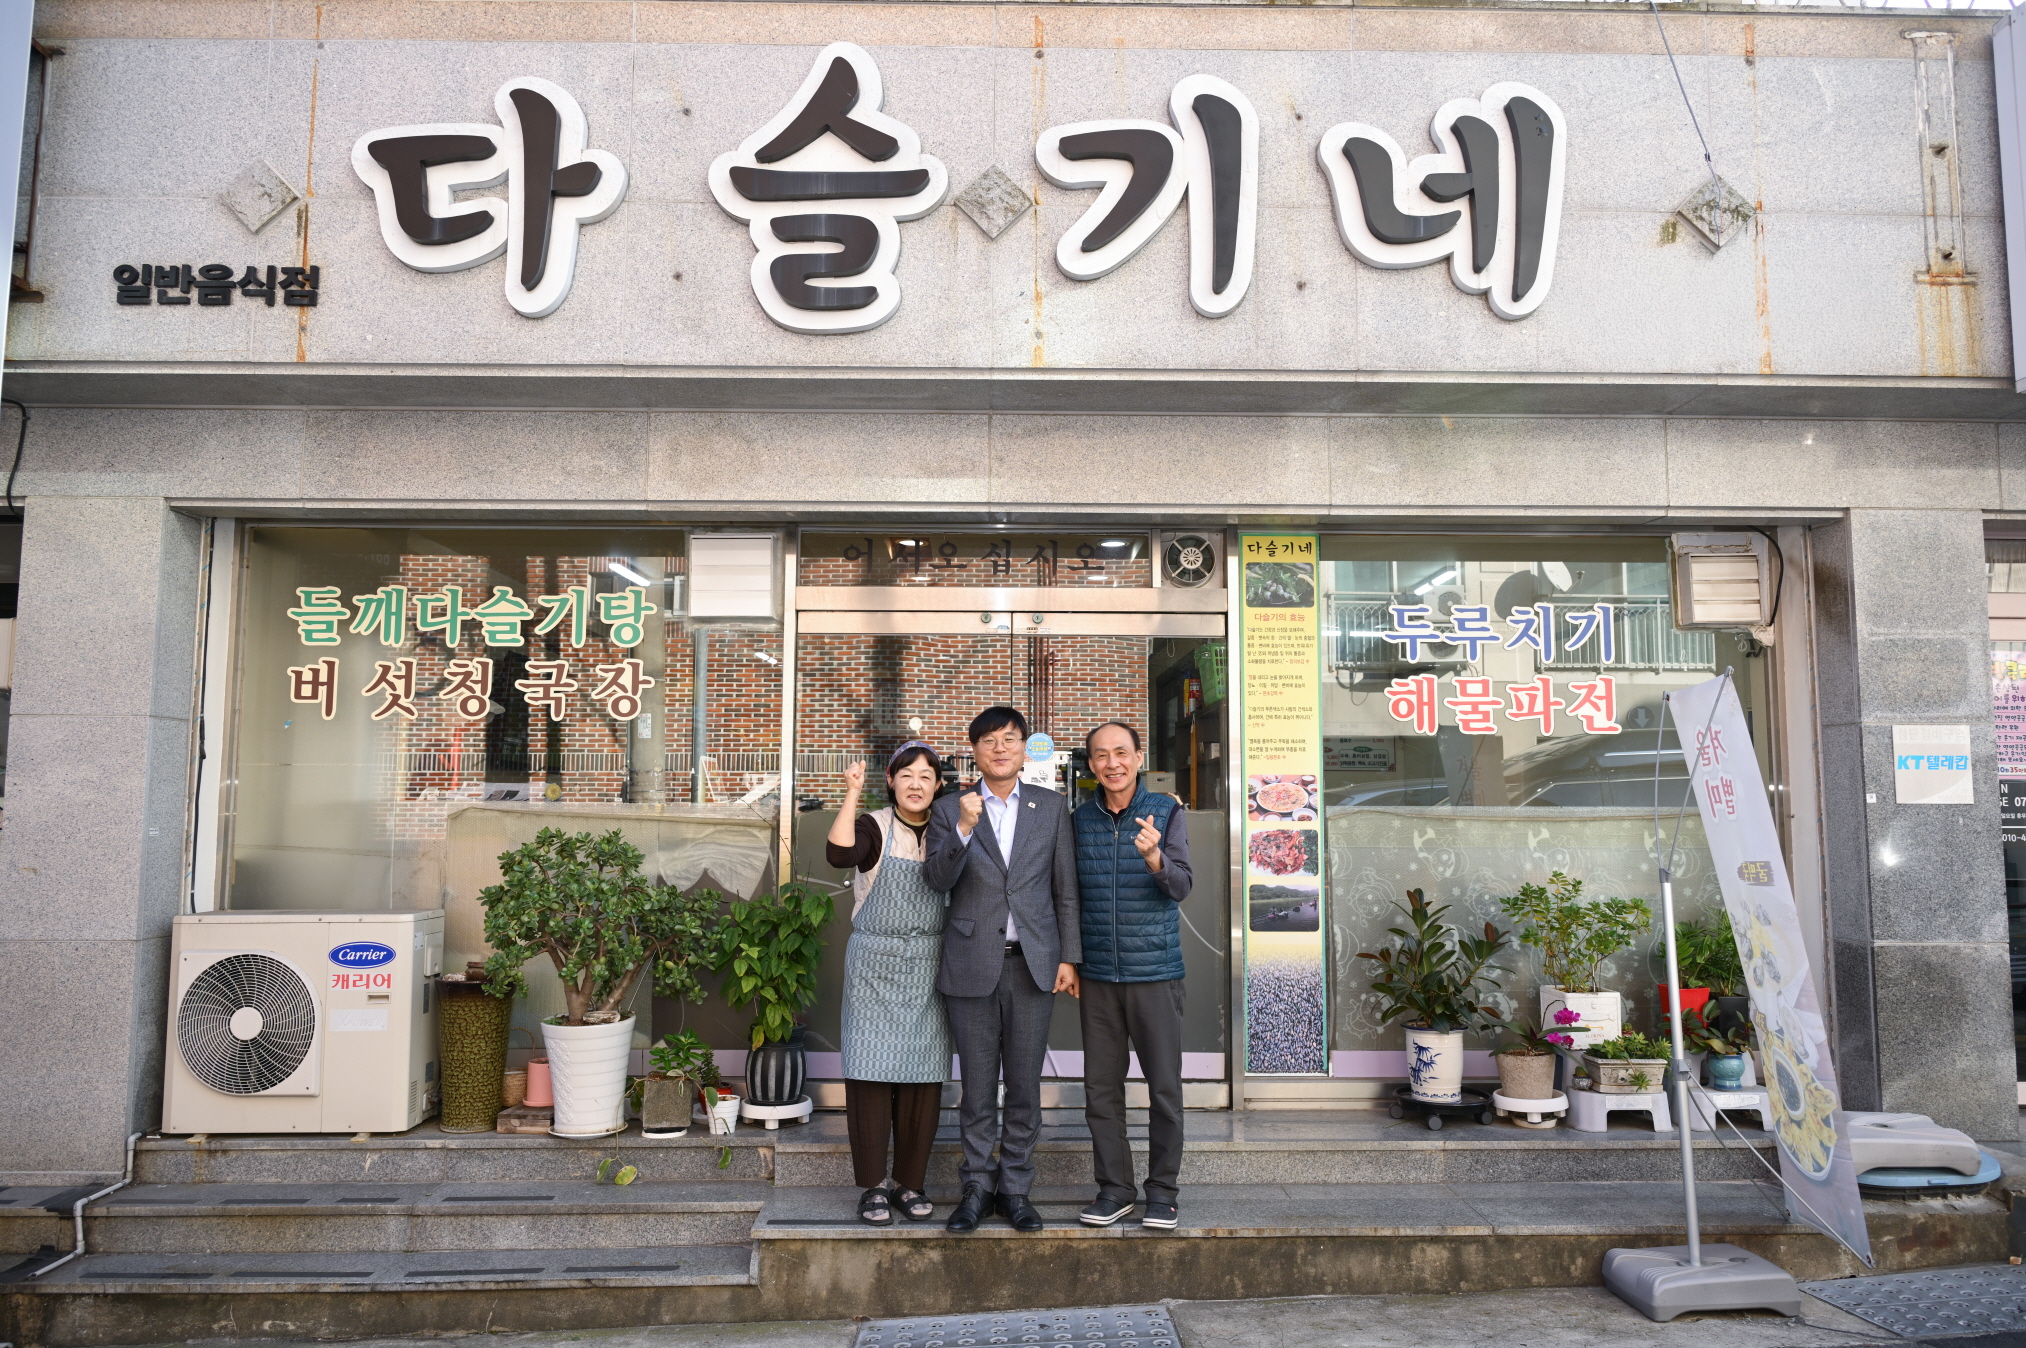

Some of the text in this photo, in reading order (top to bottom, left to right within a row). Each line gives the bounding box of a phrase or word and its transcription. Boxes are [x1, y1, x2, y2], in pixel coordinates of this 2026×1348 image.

[354, 44, 1566, 332] 다슬기네
[113, 264, 320, 307] 일반음식점
[1247, 540, 1312, 557] 다슬기네
[287, 586, 658, 648] 들깨다슬기탕
[1254, 613, 1306, 622] 다슬기의 효능
[1382, 602, 1616, 664] 두루치기
[287, 657, 655, 721] 버섯청국장
[1383, 674, 1622, 736] 해물파전
[339, 948, 387, 961] Carrier
[331, 973, 392, 989] 캐리어
